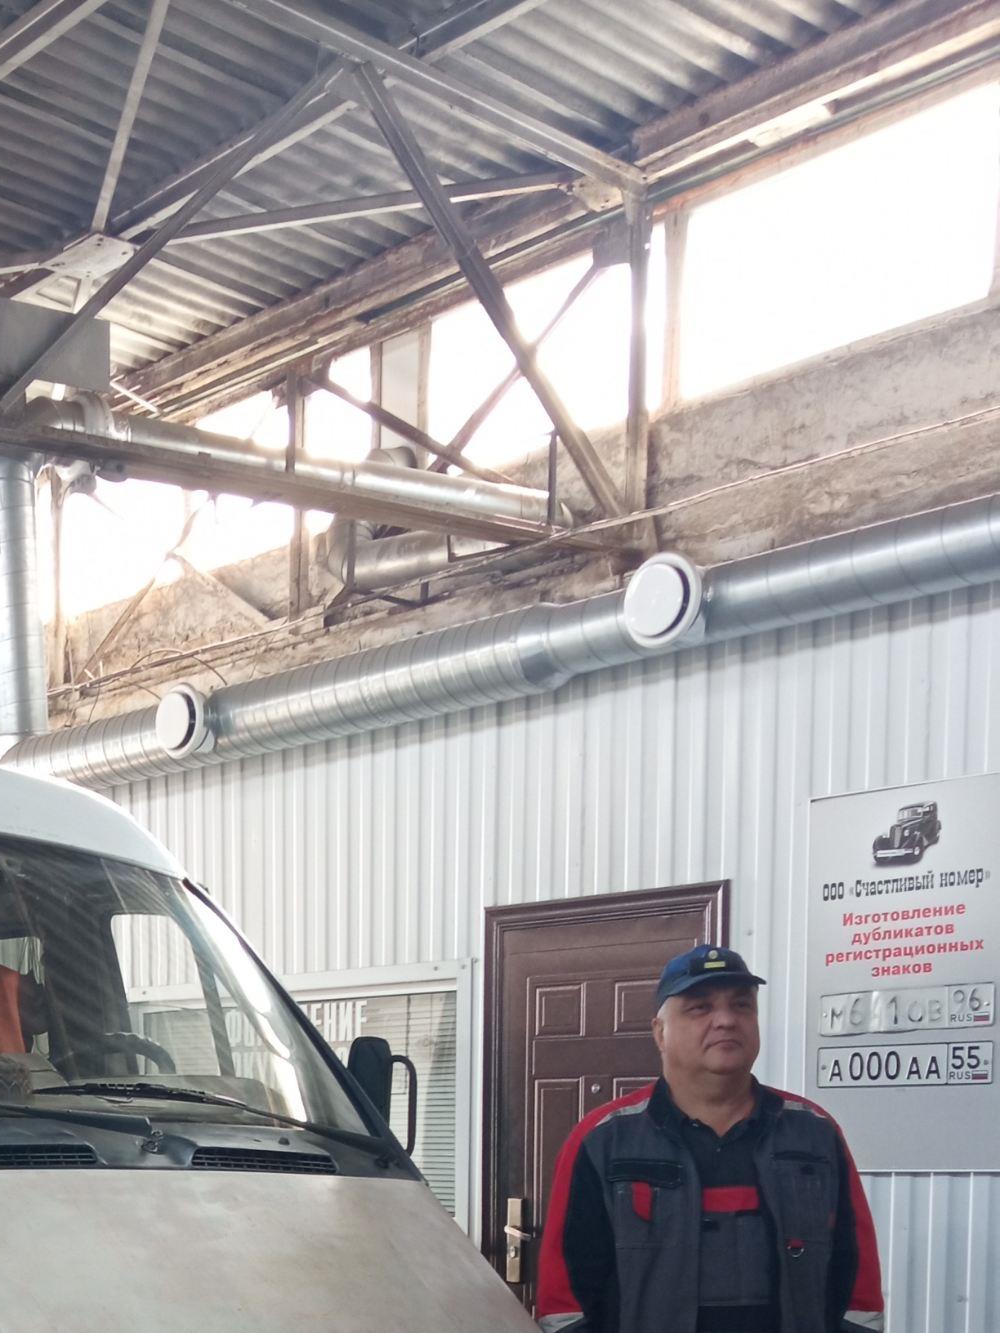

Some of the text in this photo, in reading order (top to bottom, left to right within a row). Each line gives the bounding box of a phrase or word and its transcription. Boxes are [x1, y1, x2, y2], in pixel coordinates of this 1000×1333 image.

[822, 881, 845, 901] ООО
[842, 903, 967, 927] Изготовление
[851, 923, 955, 946] дубликатов
[825, 938, 985, 967] регистрационных
[871, 962, 933, 978] знаков
[950, 1012, 973, 1023] RUS
[951, 1045, 981, 1070] 55
[949, 1071, 971, 1080] RUS
